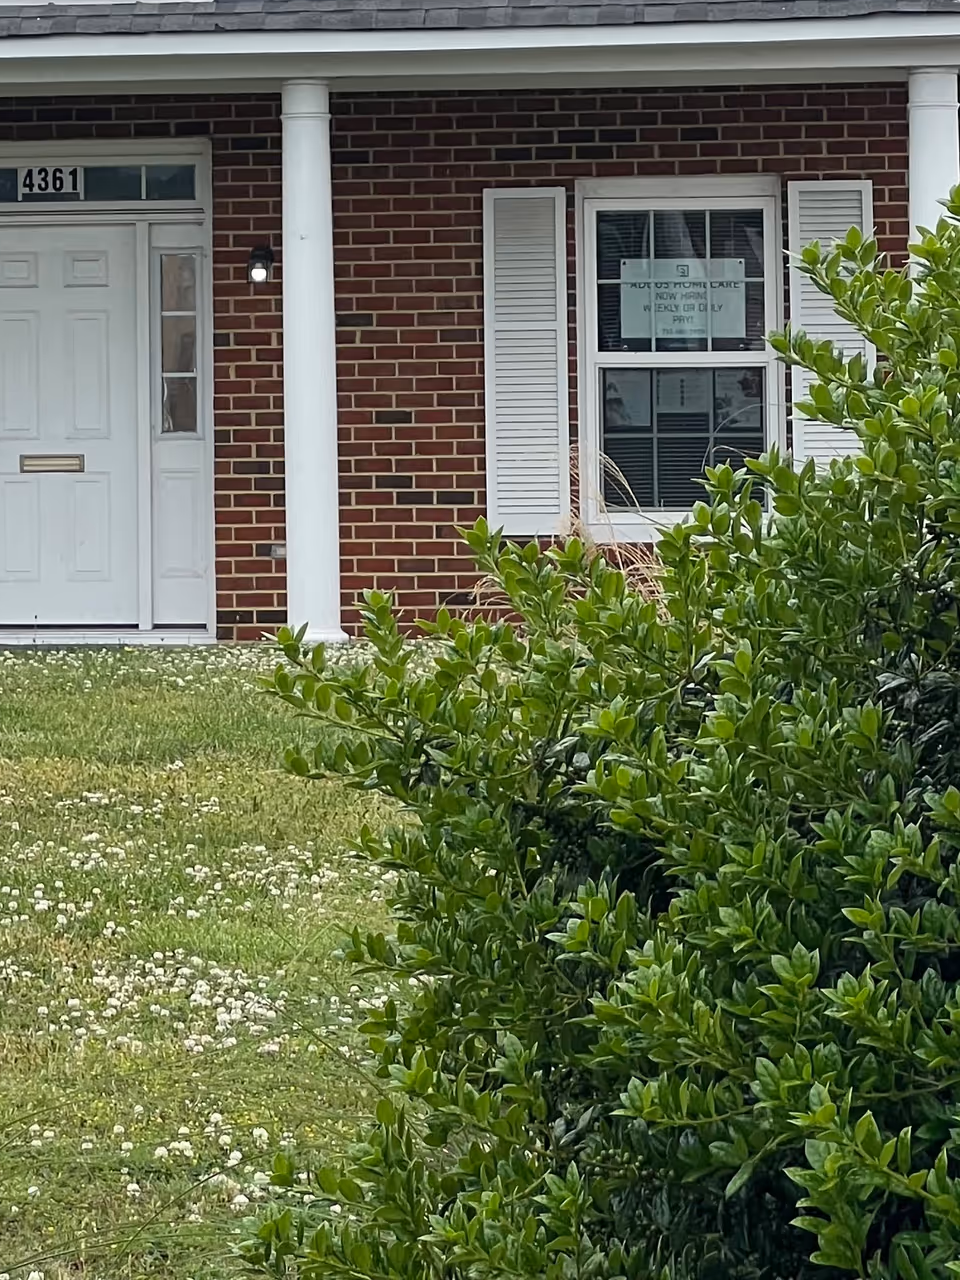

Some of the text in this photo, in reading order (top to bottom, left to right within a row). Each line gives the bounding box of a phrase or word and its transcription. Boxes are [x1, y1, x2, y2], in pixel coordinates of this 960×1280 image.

[22, 167, 78, 192] 4361
[655, 292, 677, 300] NOW
[683, 304, 696, 312] OR
[672, 315, 694, 324] PAY!
